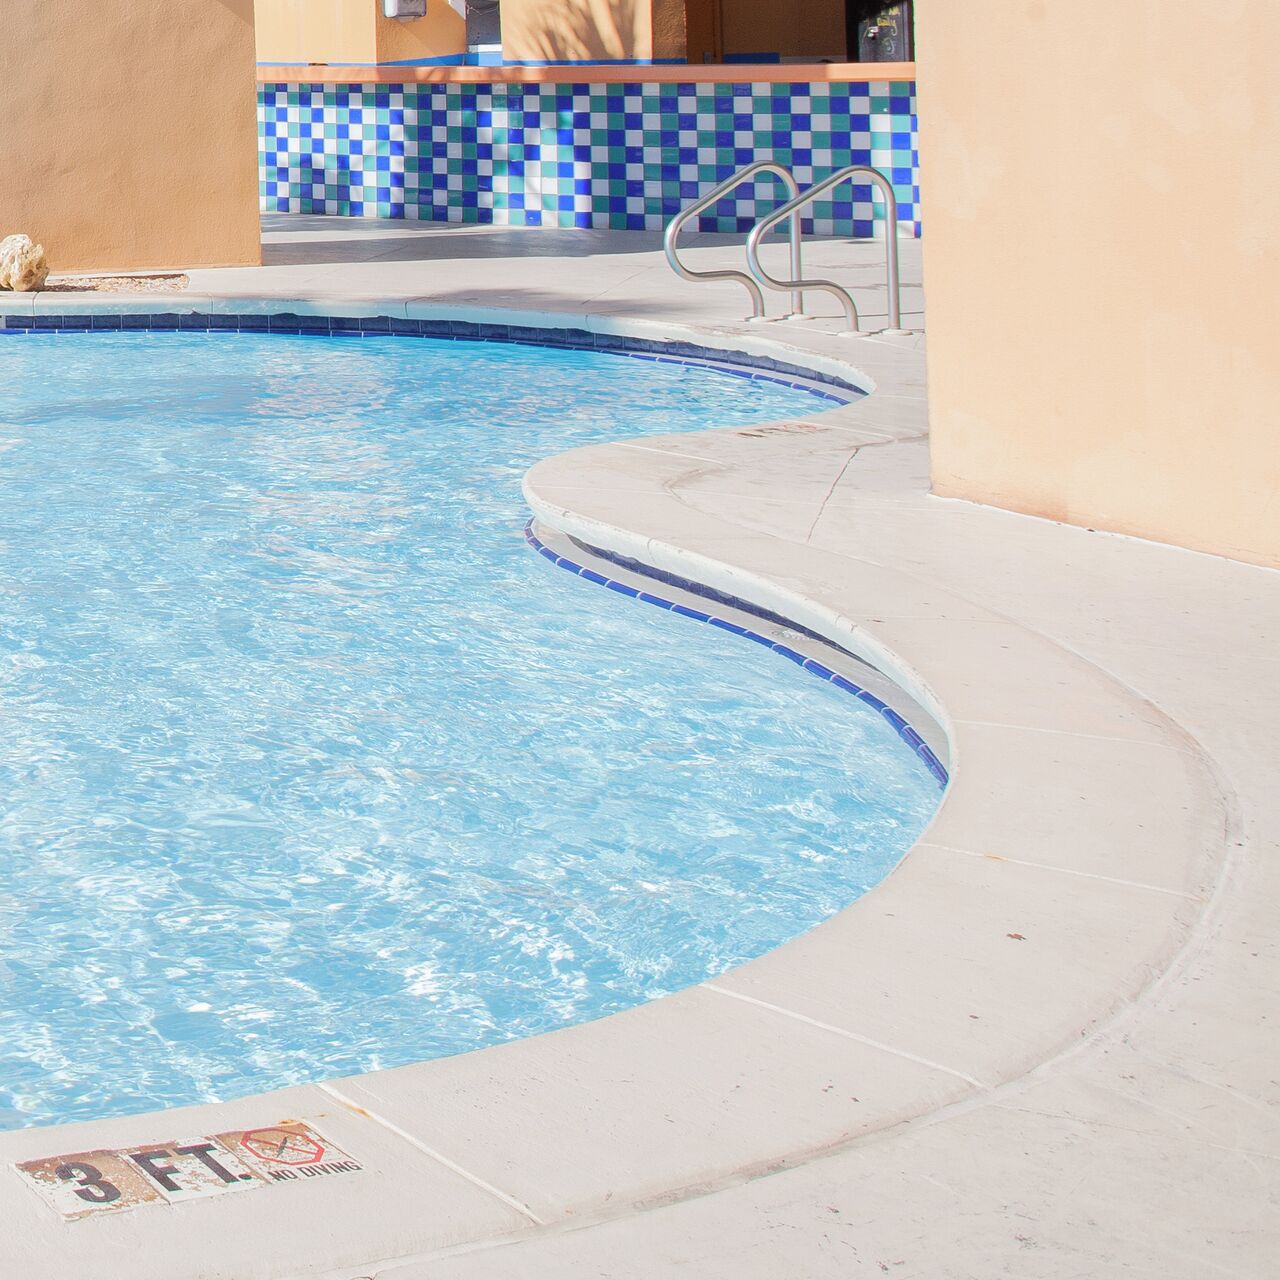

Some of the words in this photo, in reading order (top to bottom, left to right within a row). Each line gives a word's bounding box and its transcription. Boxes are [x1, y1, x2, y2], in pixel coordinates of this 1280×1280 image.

[54, 1161, 122, 1203] 3
[129, 1143, 252, 1192] FT.
[267, 1169, 298, 1182] NO
[297, 1160, 363, 1178] DIVING
